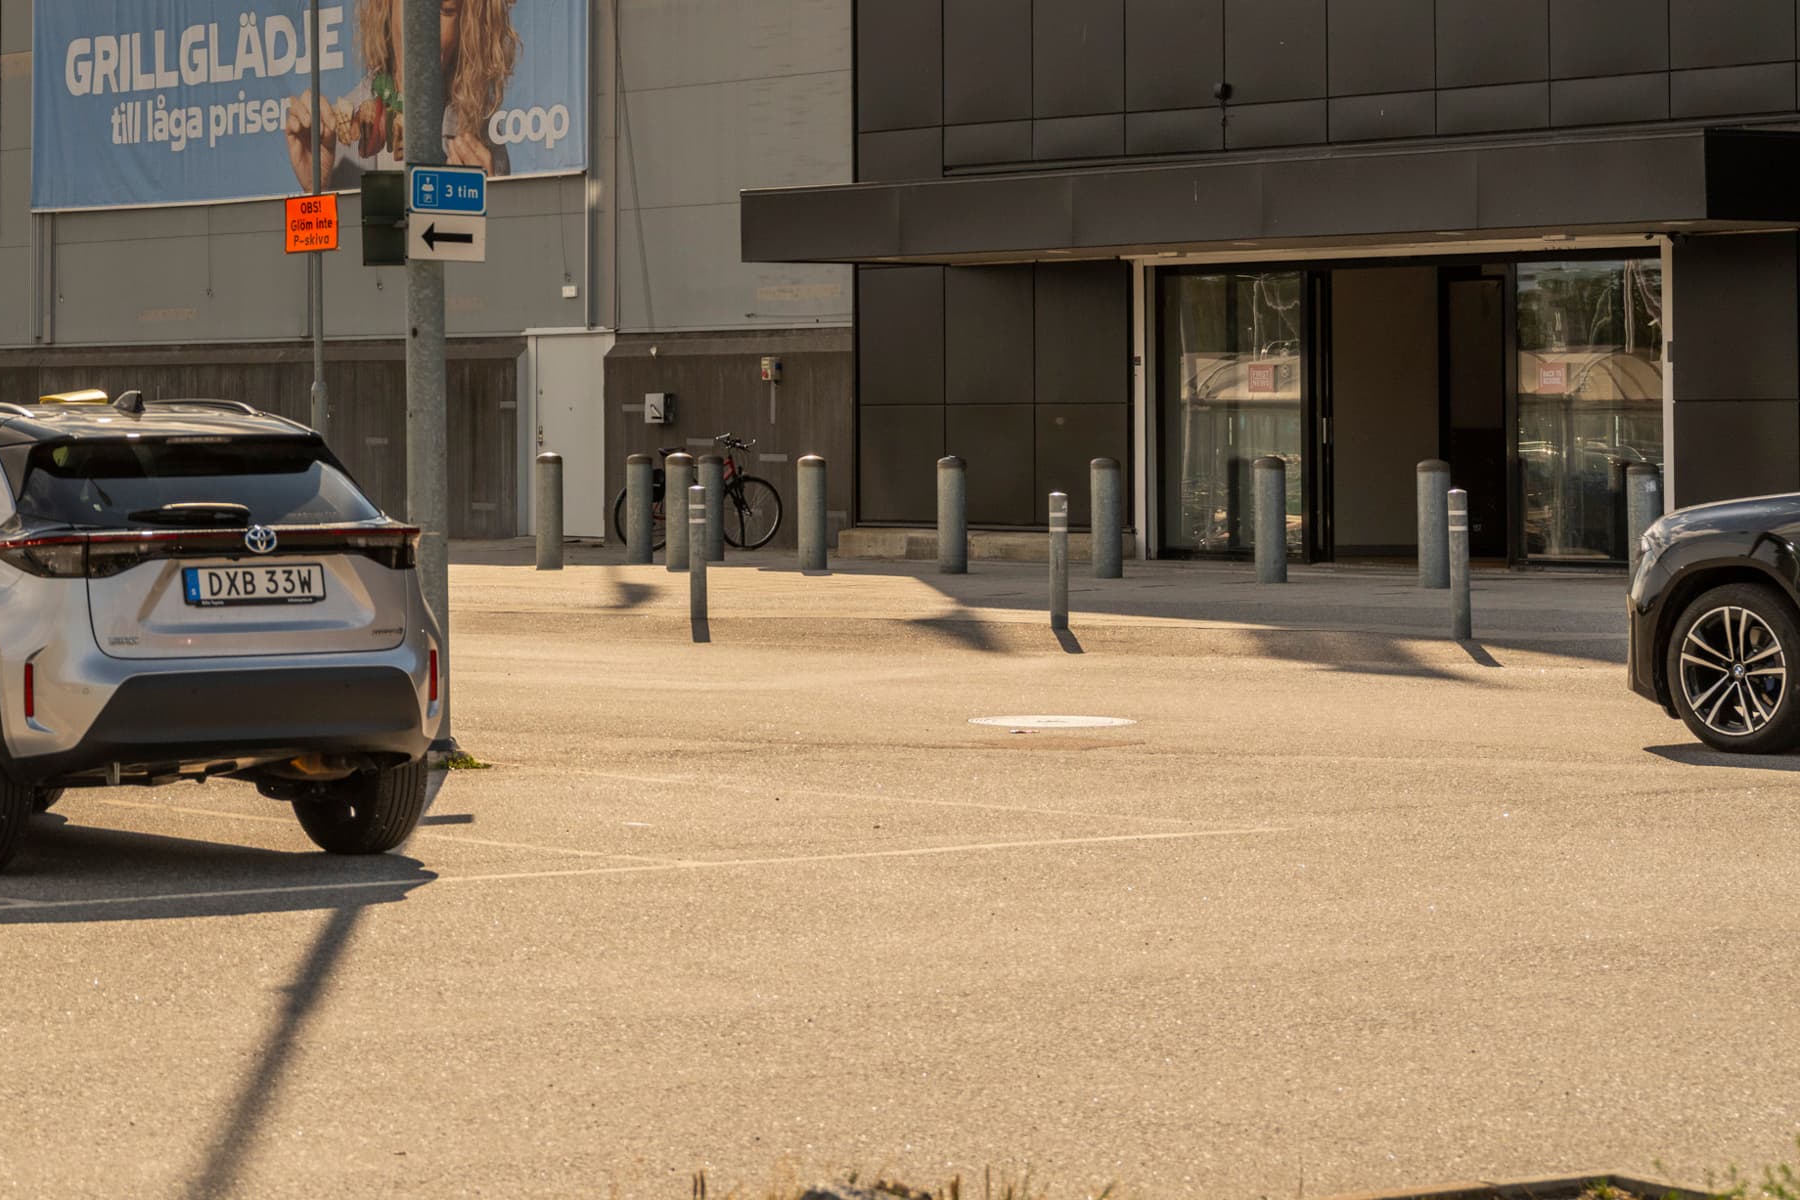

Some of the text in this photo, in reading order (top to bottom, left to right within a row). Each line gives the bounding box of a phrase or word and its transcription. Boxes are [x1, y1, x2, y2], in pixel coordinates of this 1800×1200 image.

[64, 5, 343, 97] GRILLGLÄDJE
[112, 89, 290, 152] till låga priser
[488, 104, 570, 149] coop
[445, 184, 479, 199] 3 tim
[300, 201, 322, 214] OBS!
[290, 218, 333, 232] Glöm inte
[293, 234, 330, 246] P-skiva
[208, 570, 256, 597] DXB
[265, 569, 312, 594] 33W
